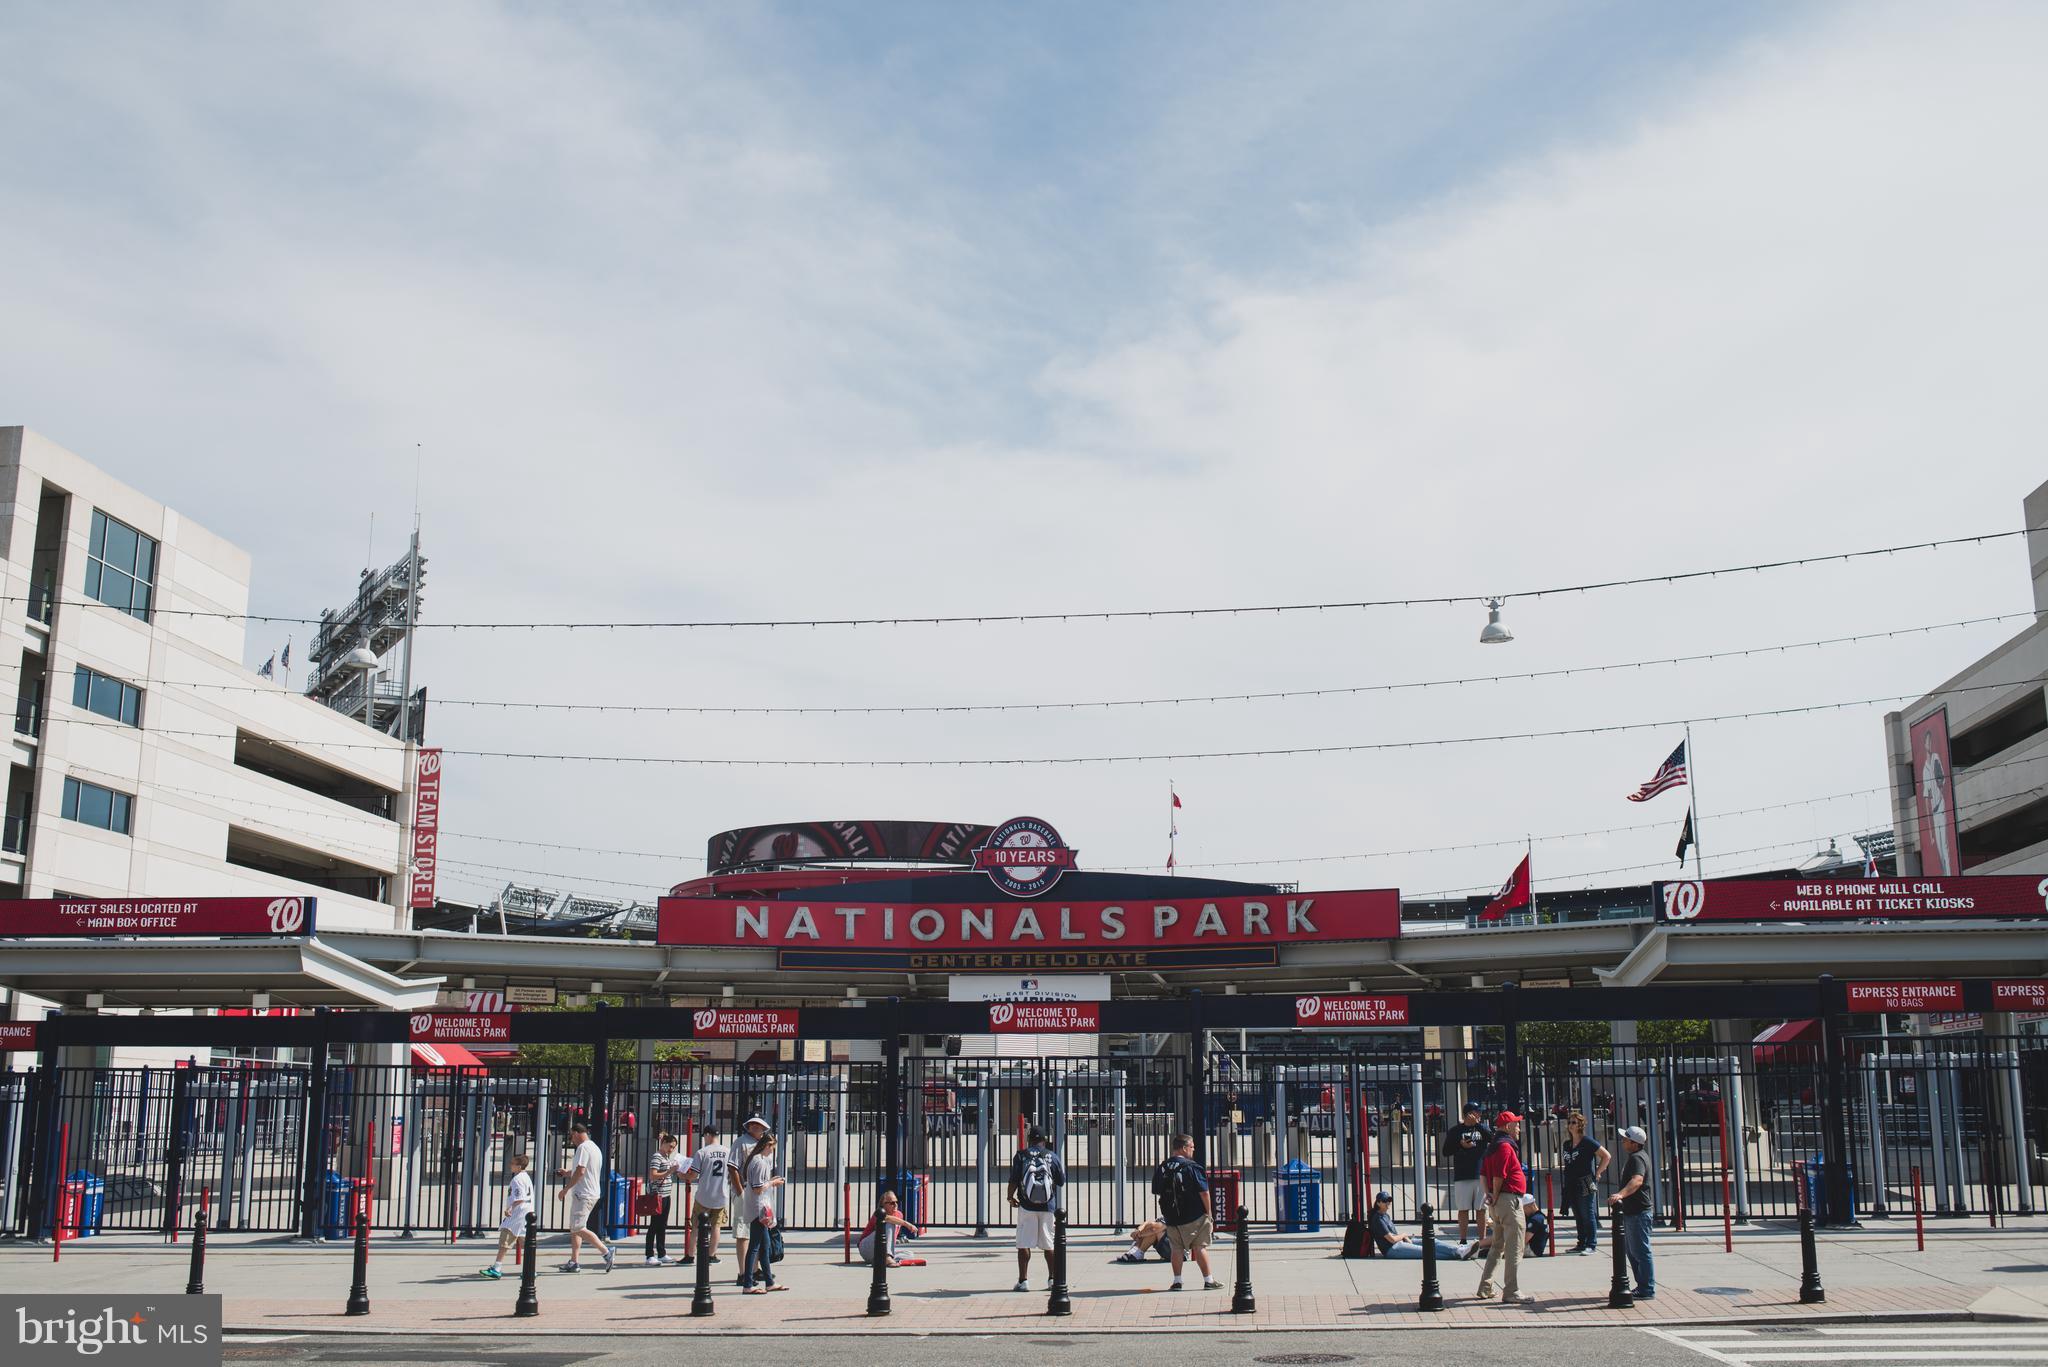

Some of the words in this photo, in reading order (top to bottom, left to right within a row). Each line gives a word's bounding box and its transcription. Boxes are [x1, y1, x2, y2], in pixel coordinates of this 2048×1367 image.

[417, 780, 438, 828] TEAM
[993, 822, 1026, 846] NATIONALS
[1028, 822, 1057, 846] BASEBALL
[995, 851, 1007, 863] 10
[1009, 851, 1056, 863] YEARS
[414, 834, 435, 893] STORE
[1004, 880, 1021, 890] 2005
[1028, 880, 1045, 890] 2015
[1797, 885, 1822, 896] WEB
[1825, 885, 1833, 895] &
[1836, 884, 1876, 895] PHONE
[1880, 884, 1910, 894] WILL
[1912, 883, 1944, 894] CALL
[60, 904, 97, 914] TICKET
[100, 904, 132, 914] SALES
[134, 904, 181, 914] LOCATED
[184, 904, 198, 913] AT
[1784, 900, 1852, 911] AVAILABLE
[1855, 899, 1872, 910] AT
[1875, 899, 1922, 910] TICKET
[1926, 898, 1975, 909] KIOSKS
[88, 917, 114, 928] MAIN
[117, 917, 138, 927] BOX
[141, 917, 177, 927] OFFICE
[735, 905, 1126, 941] NATIONALS
[1153, 900, 1319, 938] PARK
[910, 954, 1002, 968] CENTER
[1011, 954, 1078, 967] FIELD
[1087, 953, 1148, 966] GATE
[1035, 991, 1078, 999] DIVISION
[1852, 987, 1899, 998] EXPRESS
[1902, 986, 1957, 997] ENTRANCE
[1997, 985, 2045, 996] EXPRESS
[1323, 1001, 1371, 1012] WELCOME
[1374, 1000, 1386, 1010] TO
[1886, 999, 1899, 1008] NO
[1901, 998, 1924, 1008] BAGS
[2032, 997, 2045, 1006] NO
[1016, 1008, 1063, 1018] WELCOME
[1066, 1008, 1078, 1017] TO
[1324, 1011, 1377, 1021] NATIONALS
[1379, 1010, 1405, 1020] PARK
[434, 1018, 477, 1028] WELCOME
[480, 1018, 491, 1028] TO
[719, 1014, 764, 1024] WELCOME
[767, 1014, 778, 1024] TO
[1017, 1018, 1067, 1028] NATIONALS
[1070, 1018, 1095, 1027] PARK
[434, 1028, 481, 1037] NATIONALS
[484, 1028, 507, 1037] PARK
[719, 1024, 768, 1033] NATIONALS
[771, 1024, 795, 1033] PARK
[709, 1151, 727, 1159] JETER
[712, 1160, 723, 1177] 2
